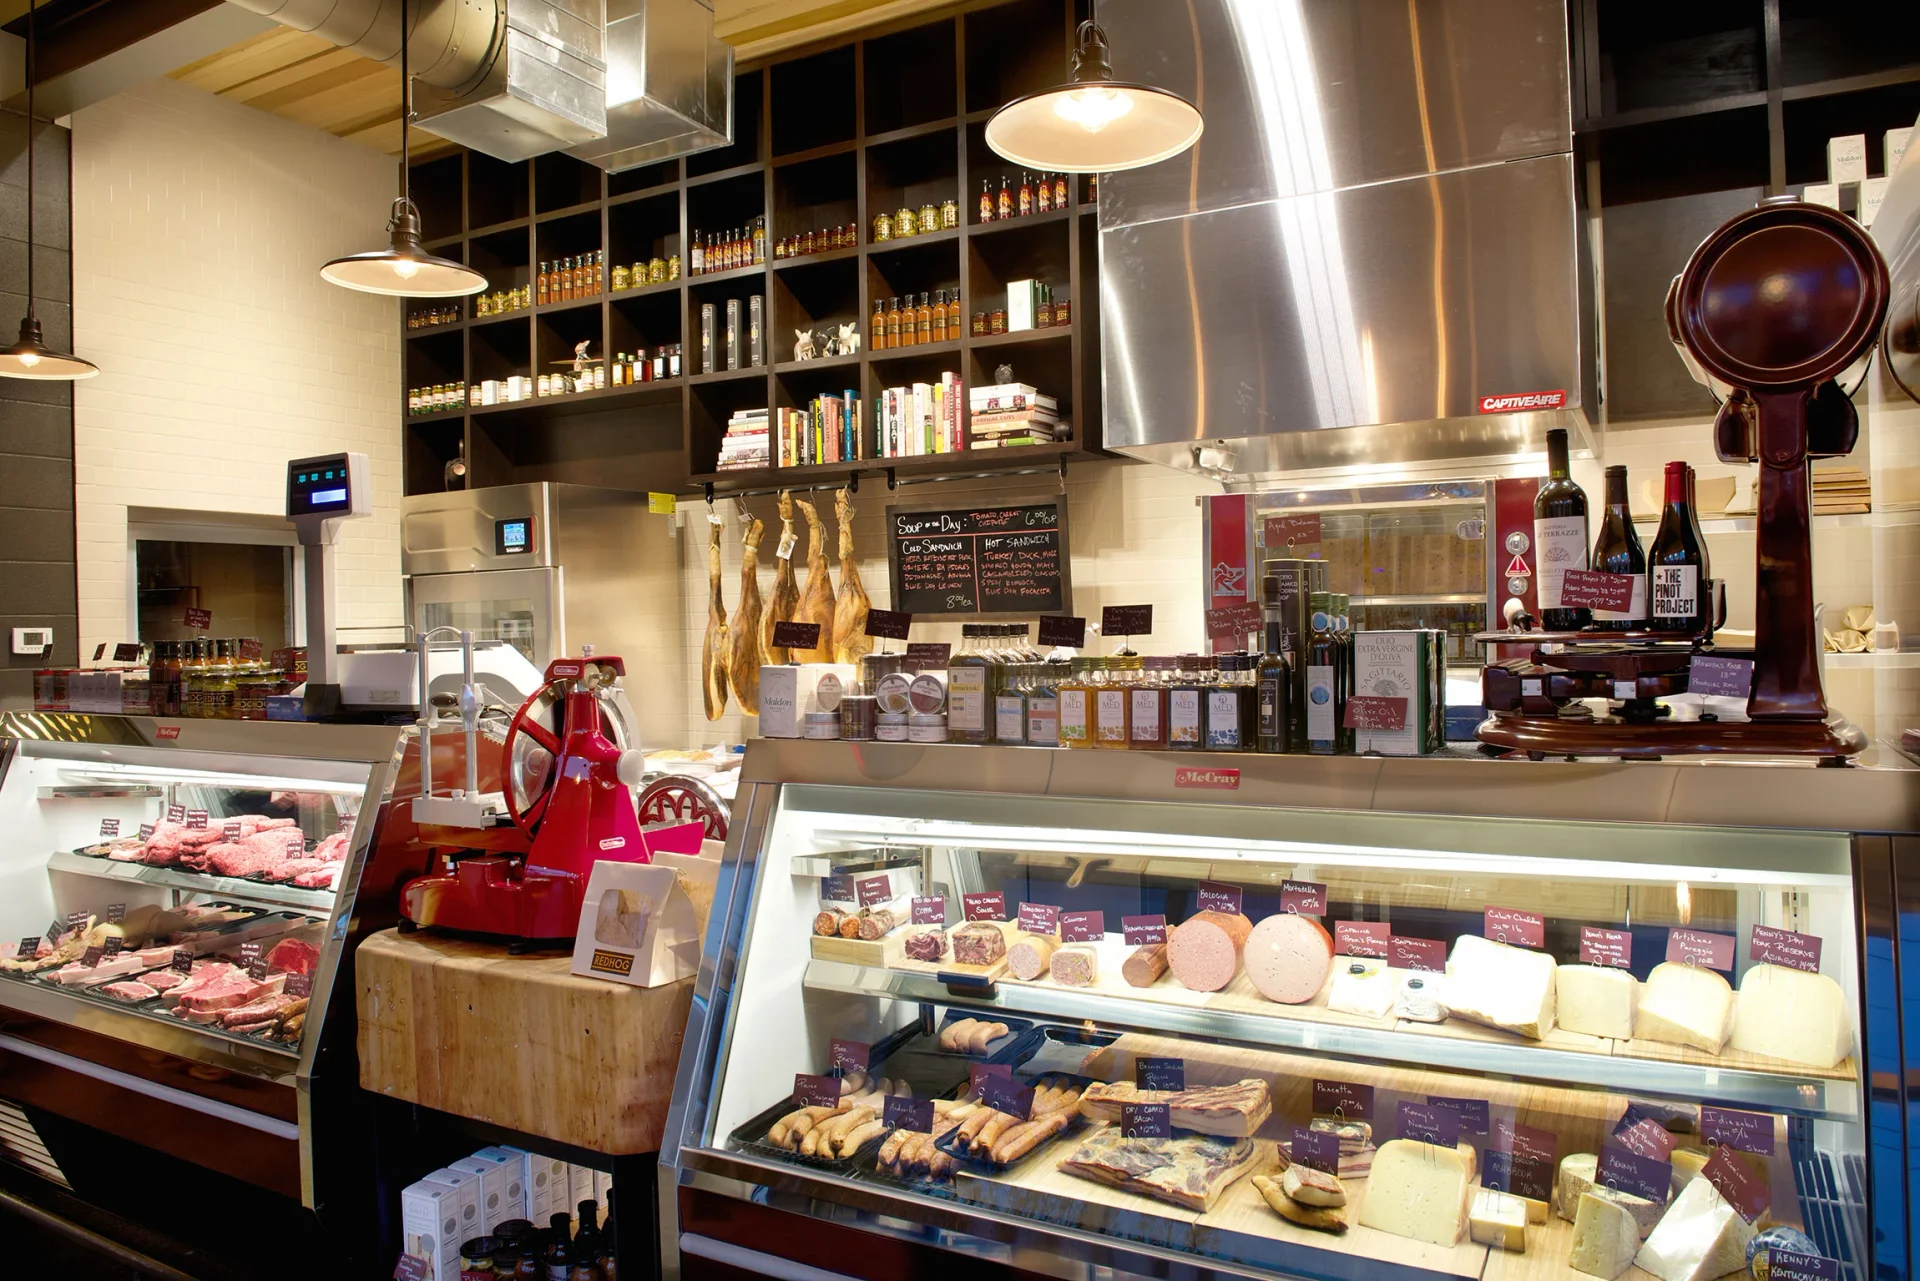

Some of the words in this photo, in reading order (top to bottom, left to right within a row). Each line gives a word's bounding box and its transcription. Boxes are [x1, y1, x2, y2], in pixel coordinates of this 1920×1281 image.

[1483, 394, 1561, 410] CAPTIVEAIRE
[1543, 530, 1579, 538] TERRAZZE
[902, 541, 921, 554] COLD
[922, 539, 962, 553] SANDWICH
[985, 538, 1003, 550] HOT
[1007, 533, 1049, 548] SANDWICH
[1664, 568, 1681, 583] THE
[1655, 584, 1681, 598] PINOT
[1655, 600, 1695, 614] PROJECT
[1358, 645, 1379, 653] EXTRA
[1379, 645, 1413, 653] VERGINE
[1370, 653, 1402, 661] D'OLIVA
[1361, 668, 1411, 690] SAGITTARIO
[764, 697, 792, 707] Maldon
[1064, 700, 1082, 709] MED
[1102, 701, 1120, 709] MED
[1136, 700, 1154, 709] MED
[1175, 700, 1194, 709] MED
[1213, 703, 1233, 712] MED
[1353, 706, 1376, 714] Olive
[1379, 708, 1396, 716] Oil
[156, 728, 178, 736] McCray
[1177, 771, 1237, 785] McCray
[1200, 890, 1228, 899] BOLOGNA
[1283, 883, 1317, 894] Mortadella
[1488, 910, 1511, 919] Cabot
[1673, 931, 1712, 944] Artikaas
[1756, 926, 1784, 940] KENNY'S
[1521, 937, 1536, 946] Cow
[1680, 941, 1713, 955] Pareggio
[1753, 937, 1771, 949] FORK
[1774, 941, 1815, 959] RESERVE
[1764, 950, 1797, 966] ASIAGO
[1317, 1083, 1352, 1094] Pancetta
[1134, 1115, 1154, 1124] BACON
[1403, 1106, 1434, 1123] Kenny's
[1294, 1130, 1319, 1143] Smoked
[1441, 1138, 1456, 1148] Cow
[1746, 1144, 1769, 1155] Sheep
[1493, 1162, 1533, 1179] ASHBROOK
[1609, 1154, 1638, 1174] KENNY'S
[1721, 1146, 1748, 1184] Pecorino
[1734, 1202, 1752, 1224] Sheep
[1776, 1251, 1821, 1269] KENNY'S
[1770, 1265, 1815, 1281] KENTUCKY
